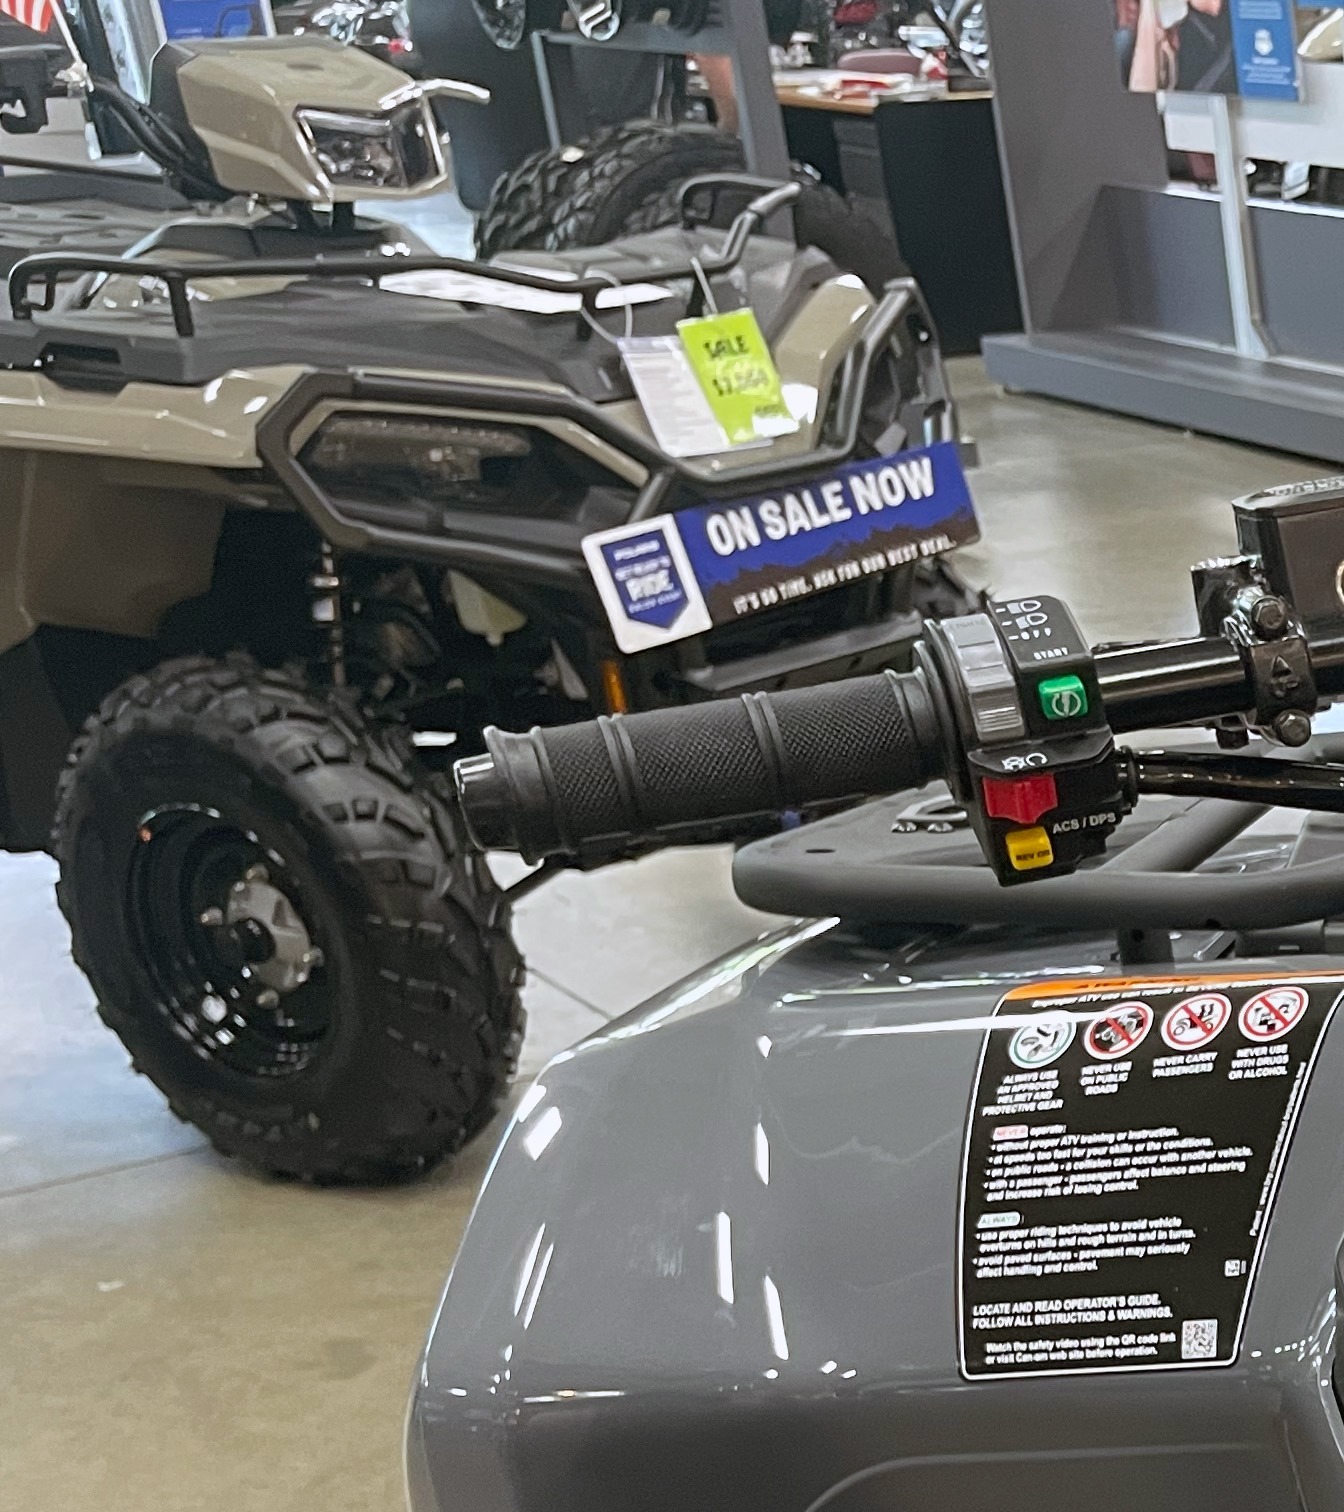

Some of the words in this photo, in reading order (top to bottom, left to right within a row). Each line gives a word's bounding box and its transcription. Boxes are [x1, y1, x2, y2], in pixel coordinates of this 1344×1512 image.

[706, 513, 761, 557] ON
[758, 480, 852, 541] SALE
[849, 457, 934, 515] NOW
[1034, 647, 1068, 660] START
[1053, 819, 1079, 834] ACS
[1089, 812, 1116, 826] DPS
[1236, 1047, 1267, 1058] NEVER
[1269, 1044, 1288, 1055] USE
[1153, 1056, 1184, 1068] NEVER
[1185, 1052, 1218, 1063] CARRY
[1232, 1058, 1254, 1069] WITH
[1152, 1063, 1214, 1078] PASSENGERS
[1228, 1069, 1243, 1080] OR
[1244, 1066, 1288, 1079] ALCOHOL
[973, 1303, 1011, 1316] LOCATE
[1012, 1302, 1033, 1314] AND
[1035, 1300, 1062, 1312] READ
[1064, 1296, 1126, 1310] OPERATOR'S
[1128, 1294, 1161, 1306] GUIDE.
[973, 1316, 1014, 1329] FOLLOW
[1014, 1315, 1033, 1326] ALL
[1034, 1310, 1106, 1326] INSTRUCTIONS
[1107, 1310, 1115, 1321] &
[1117, 1306, 1173, 1320] WARNINGS.
